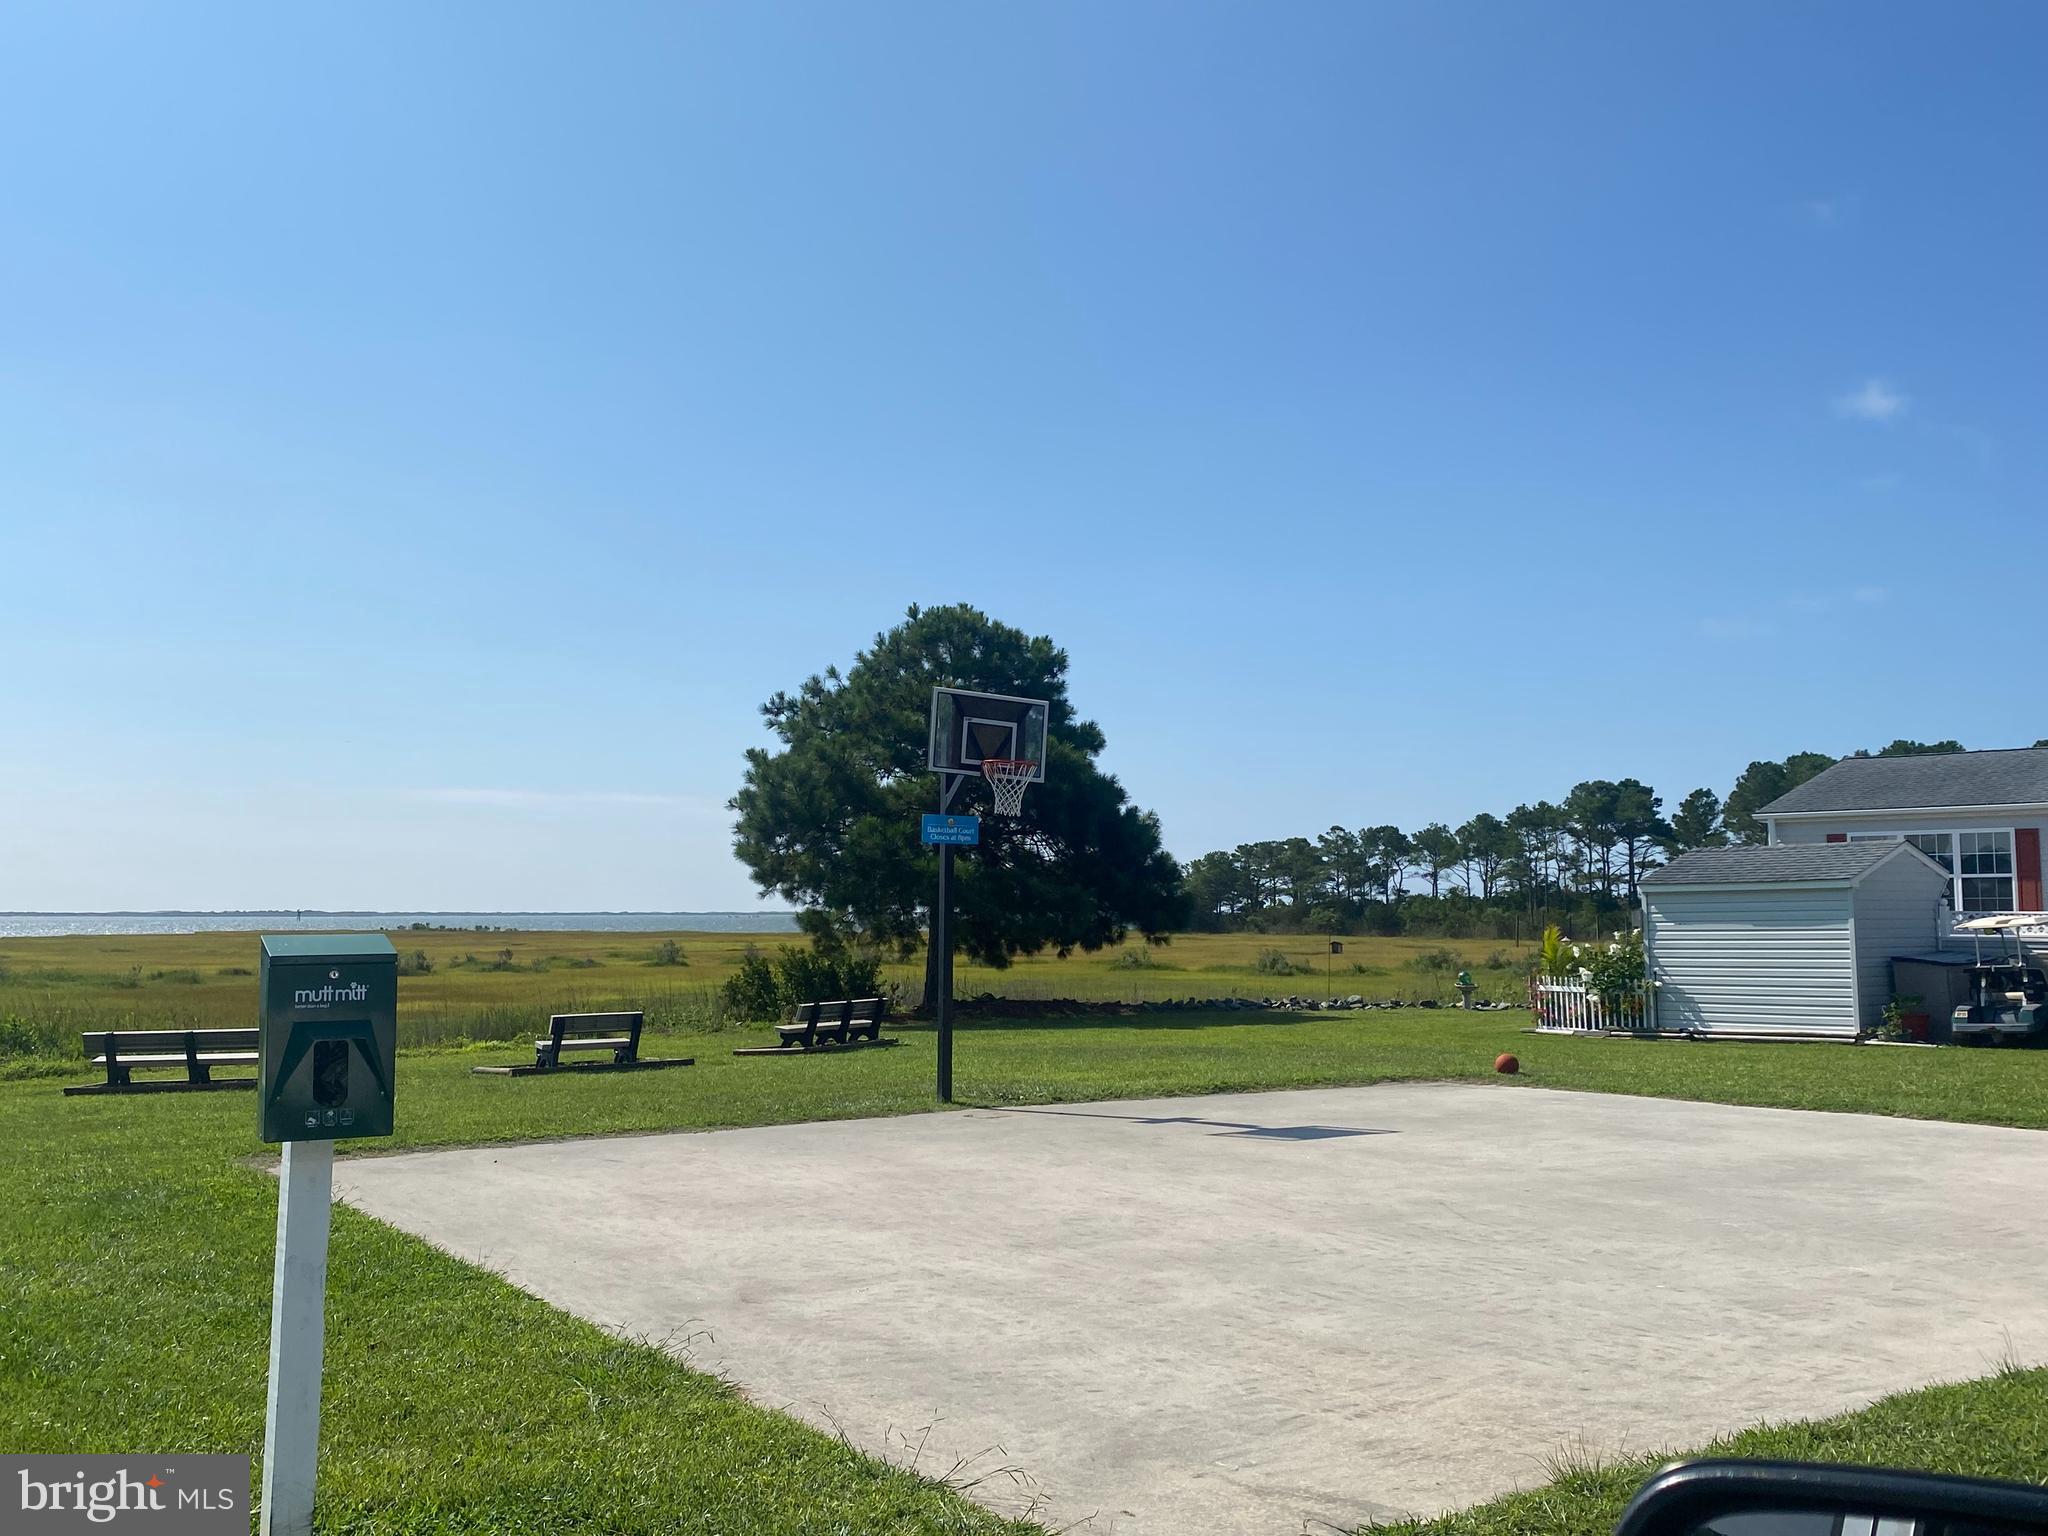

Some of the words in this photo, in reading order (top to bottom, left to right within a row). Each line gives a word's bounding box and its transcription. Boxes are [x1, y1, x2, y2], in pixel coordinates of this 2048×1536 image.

[927, 826, 958, 834] Basketball
[930, 833, 950, 841] Closes
[295, 985, 334, 1003] mutt
[335, 982, 367, 1001] mitt
